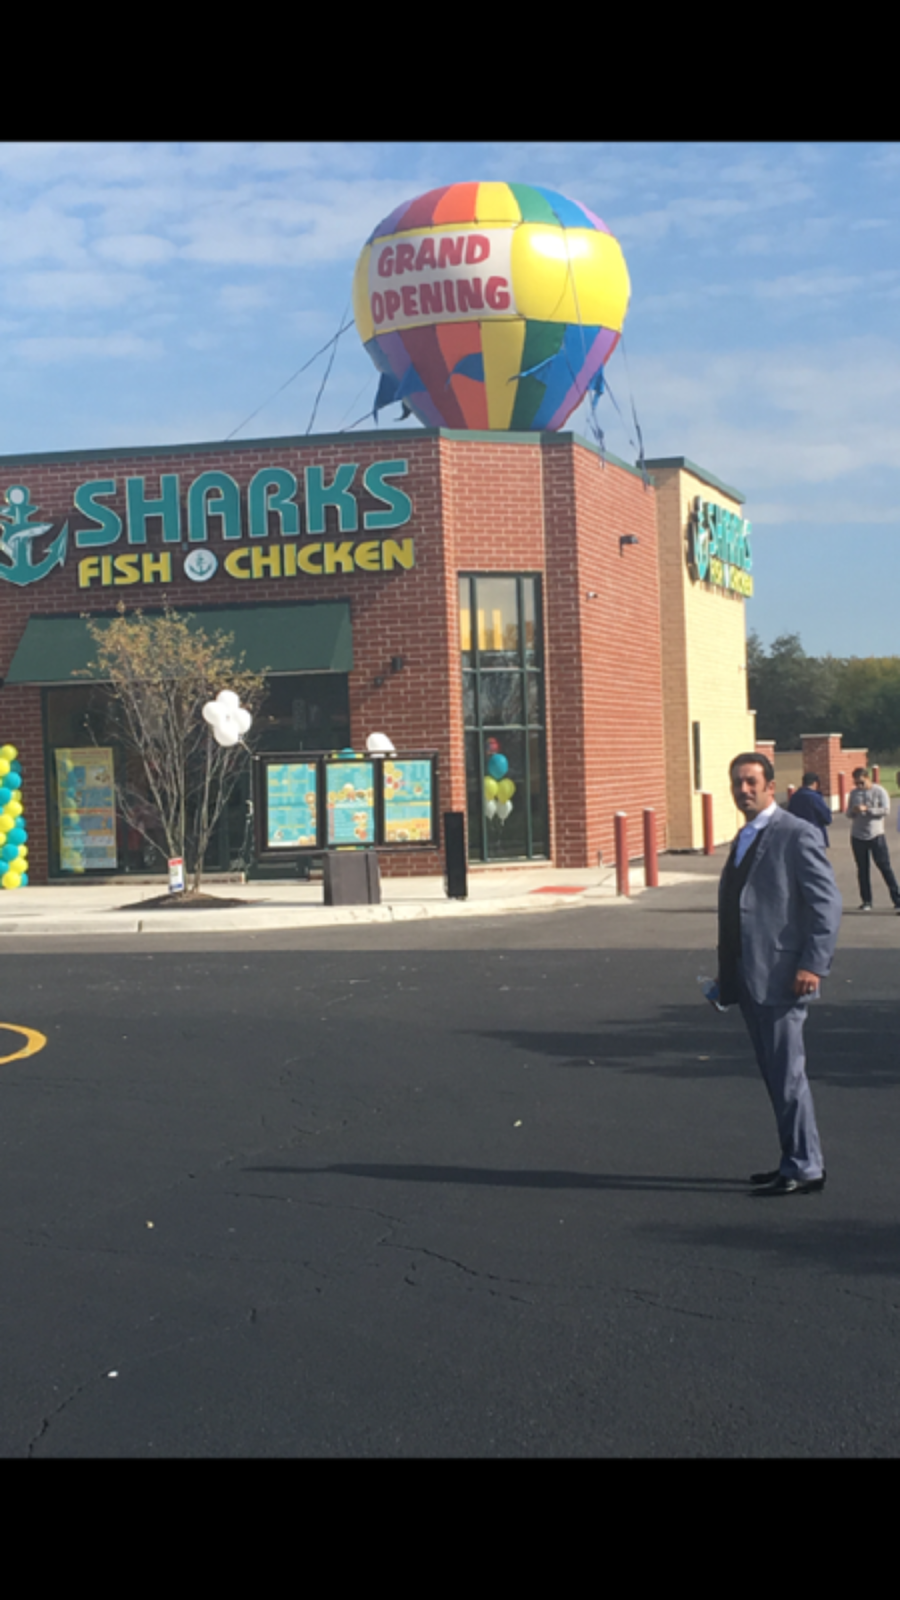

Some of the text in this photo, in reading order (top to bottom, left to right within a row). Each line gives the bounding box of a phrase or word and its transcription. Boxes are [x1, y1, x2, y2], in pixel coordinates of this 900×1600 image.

[377, 234, 491, 278] GRAND
[371, 276, 511, 324] OPENING
[74, 459, 413, 548] SHARKS
[78, 538, 415, 588] FISH CHICKEN
